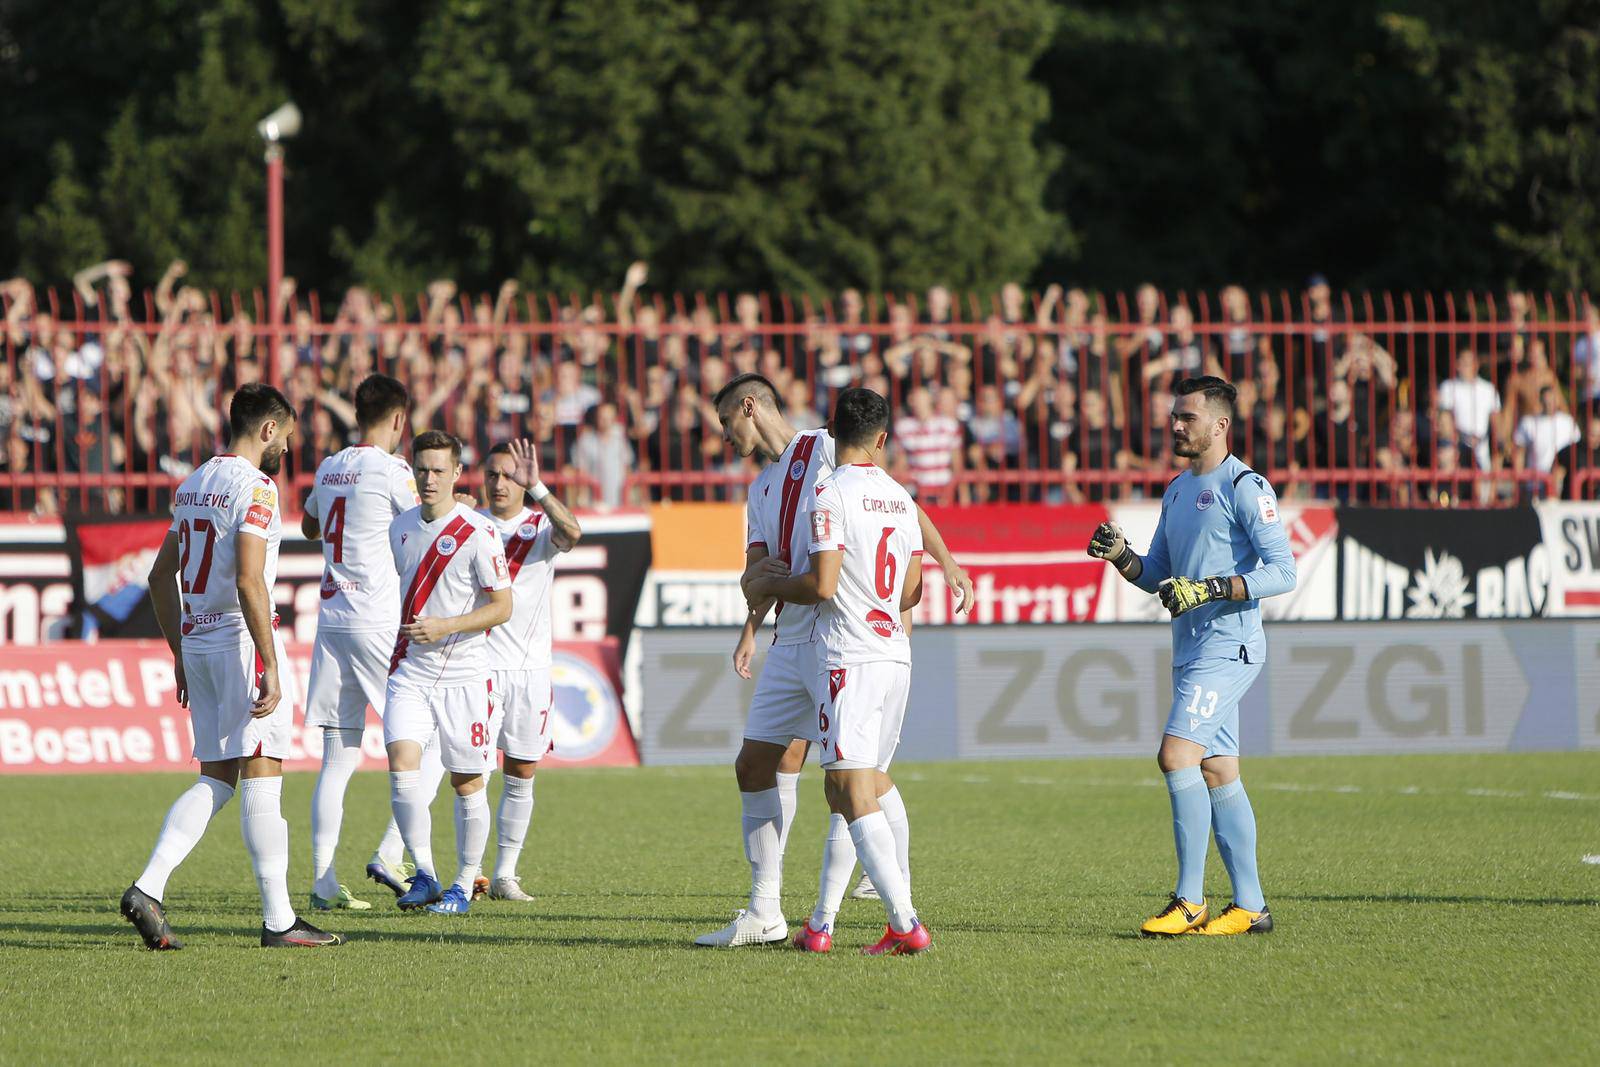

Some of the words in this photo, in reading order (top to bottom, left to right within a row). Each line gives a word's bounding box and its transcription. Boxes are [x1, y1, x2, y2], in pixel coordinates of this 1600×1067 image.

[322, 470, 361, 485] BARIŠIĆ
[323, 496, 346, 564] 4
[178, 518, 216, 594] 27
[875, 527, 896, 603] 6
[0, 658, 136, 709] m:tel
[1185, 685, 1218, 719] 13
[1289, 643, 1486, 740] ZGI
[0, 718, 155, 765] Bosne
[159, 716, 182, 763] i
[819, 703, 830, 733] 6
